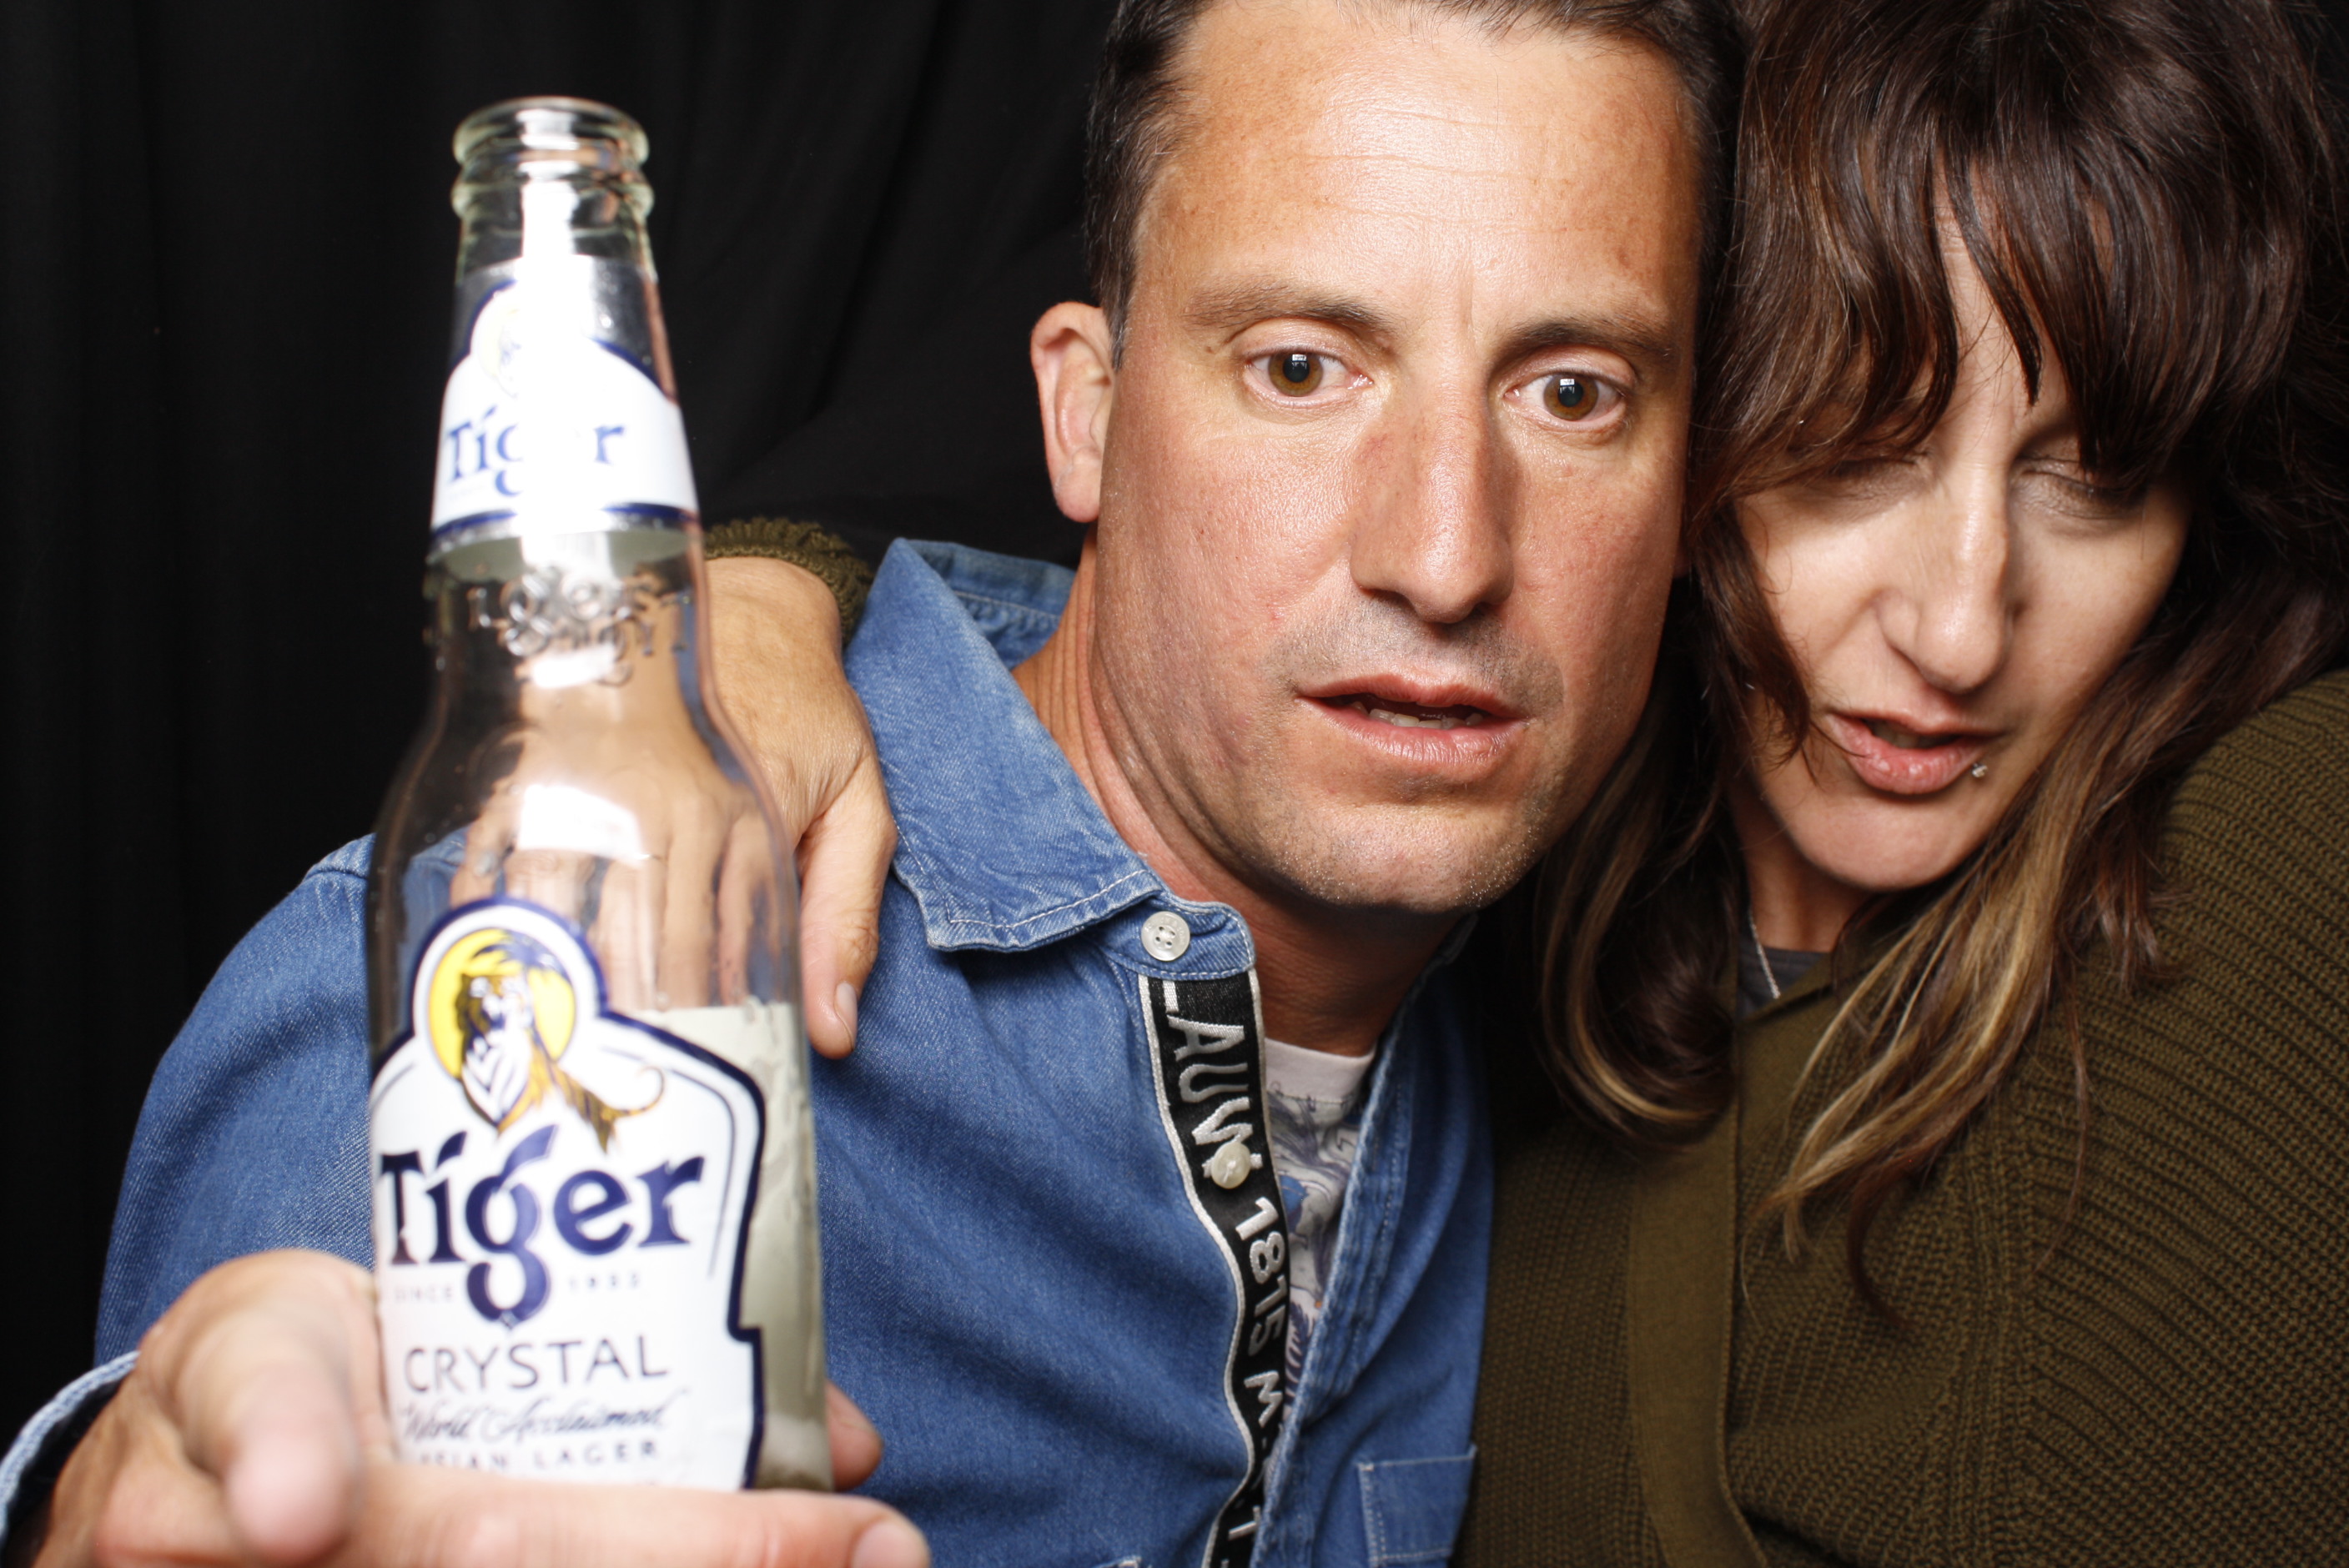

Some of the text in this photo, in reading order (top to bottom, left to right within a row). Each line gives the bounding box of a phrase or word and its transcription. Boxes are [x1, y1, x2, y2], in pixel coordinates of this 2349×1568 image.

[380, 1123, 704, 1324] Tiger
[403, 1335, 670, 1392] CRYSTAL
[534, 1440, 658, 1470] LAGER
